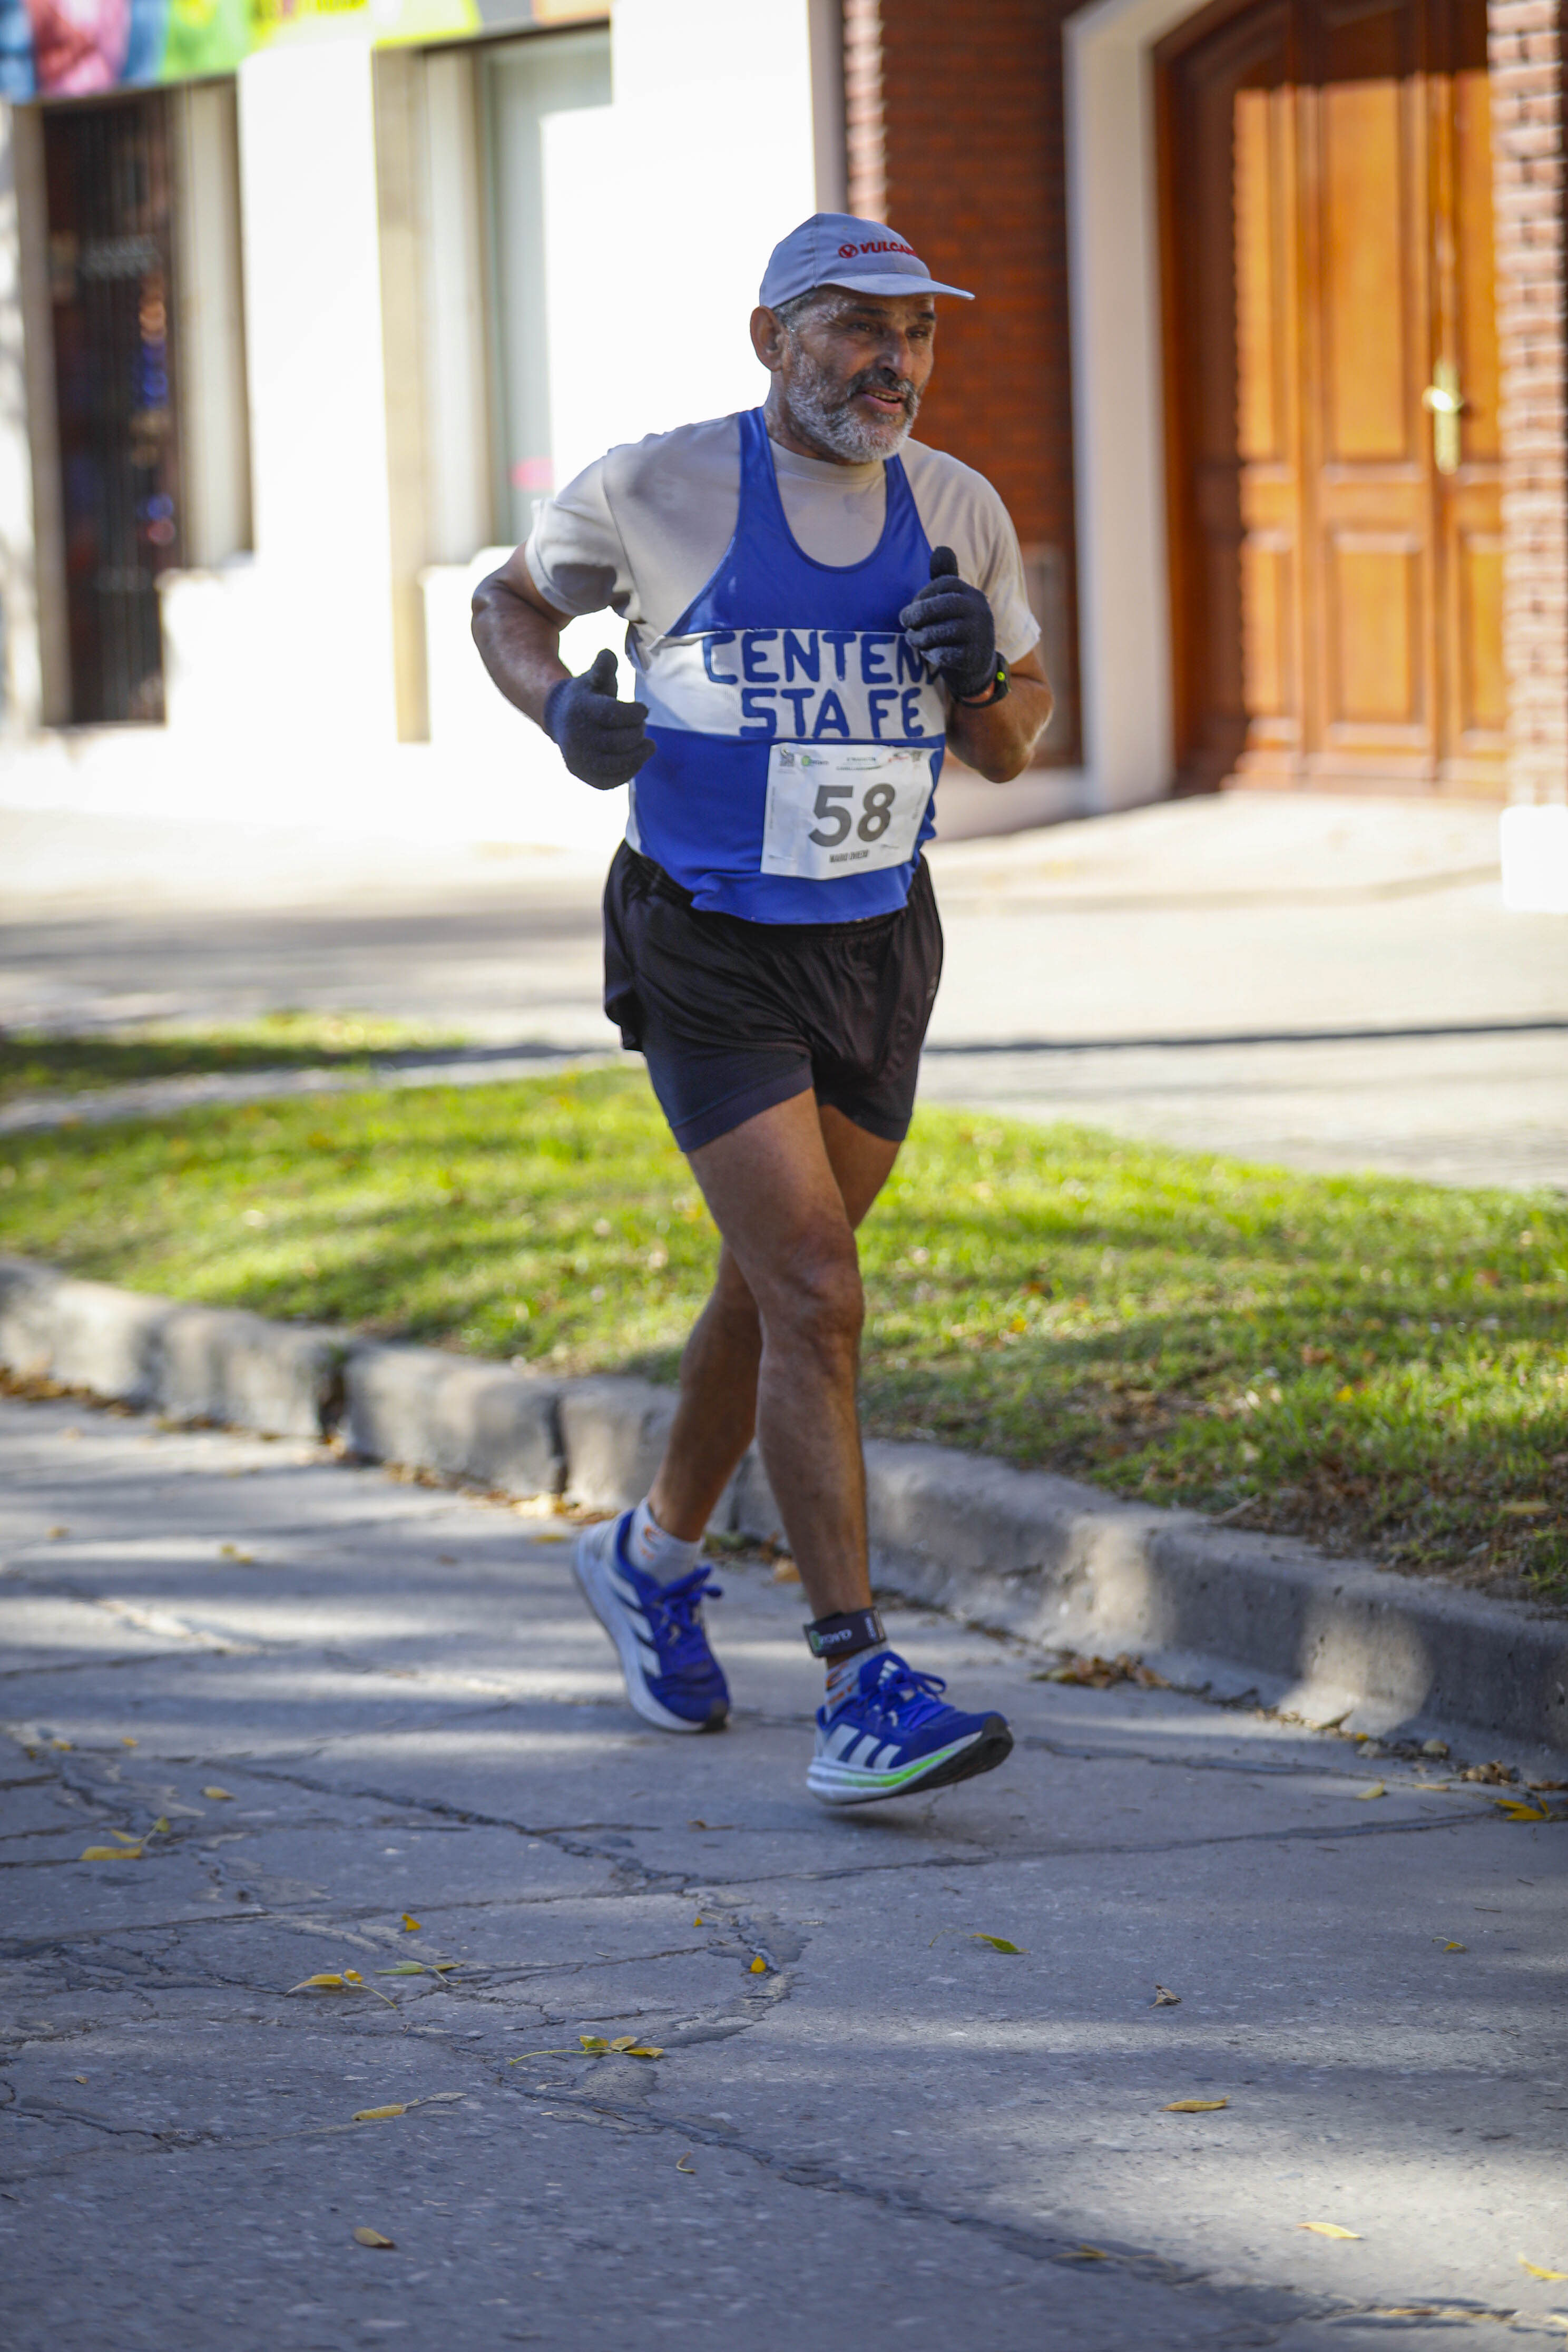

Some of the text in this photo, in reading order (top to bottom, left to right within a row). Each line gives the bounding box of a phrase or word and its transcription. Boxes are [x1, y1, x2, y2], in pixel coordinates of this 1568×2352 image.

[740, 687, 924, 738] STA FE
[808, 783, 896, 847] 58
